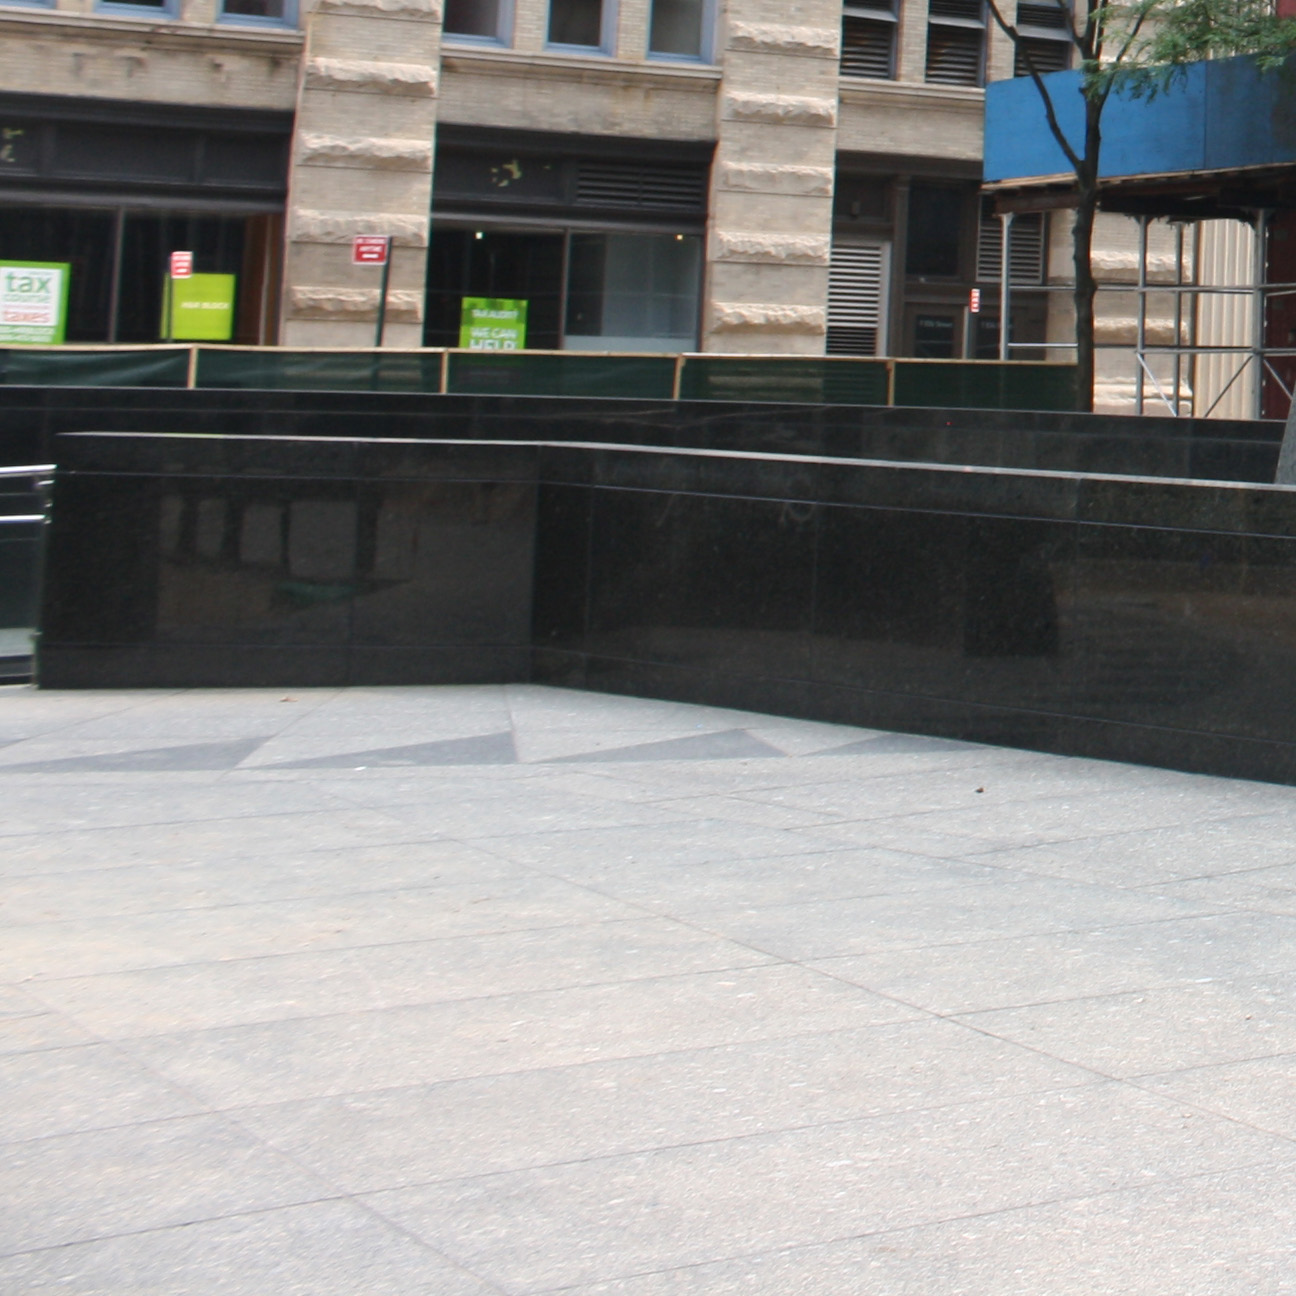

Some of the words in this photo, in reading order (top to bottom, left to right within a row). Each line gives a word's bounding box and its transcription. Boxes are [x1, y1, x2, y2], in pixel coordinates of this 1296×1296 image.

[5, 272, 51, 293] tax
[469, 327, 491, 339] WE
[492, 328, 518, 340] CAN
